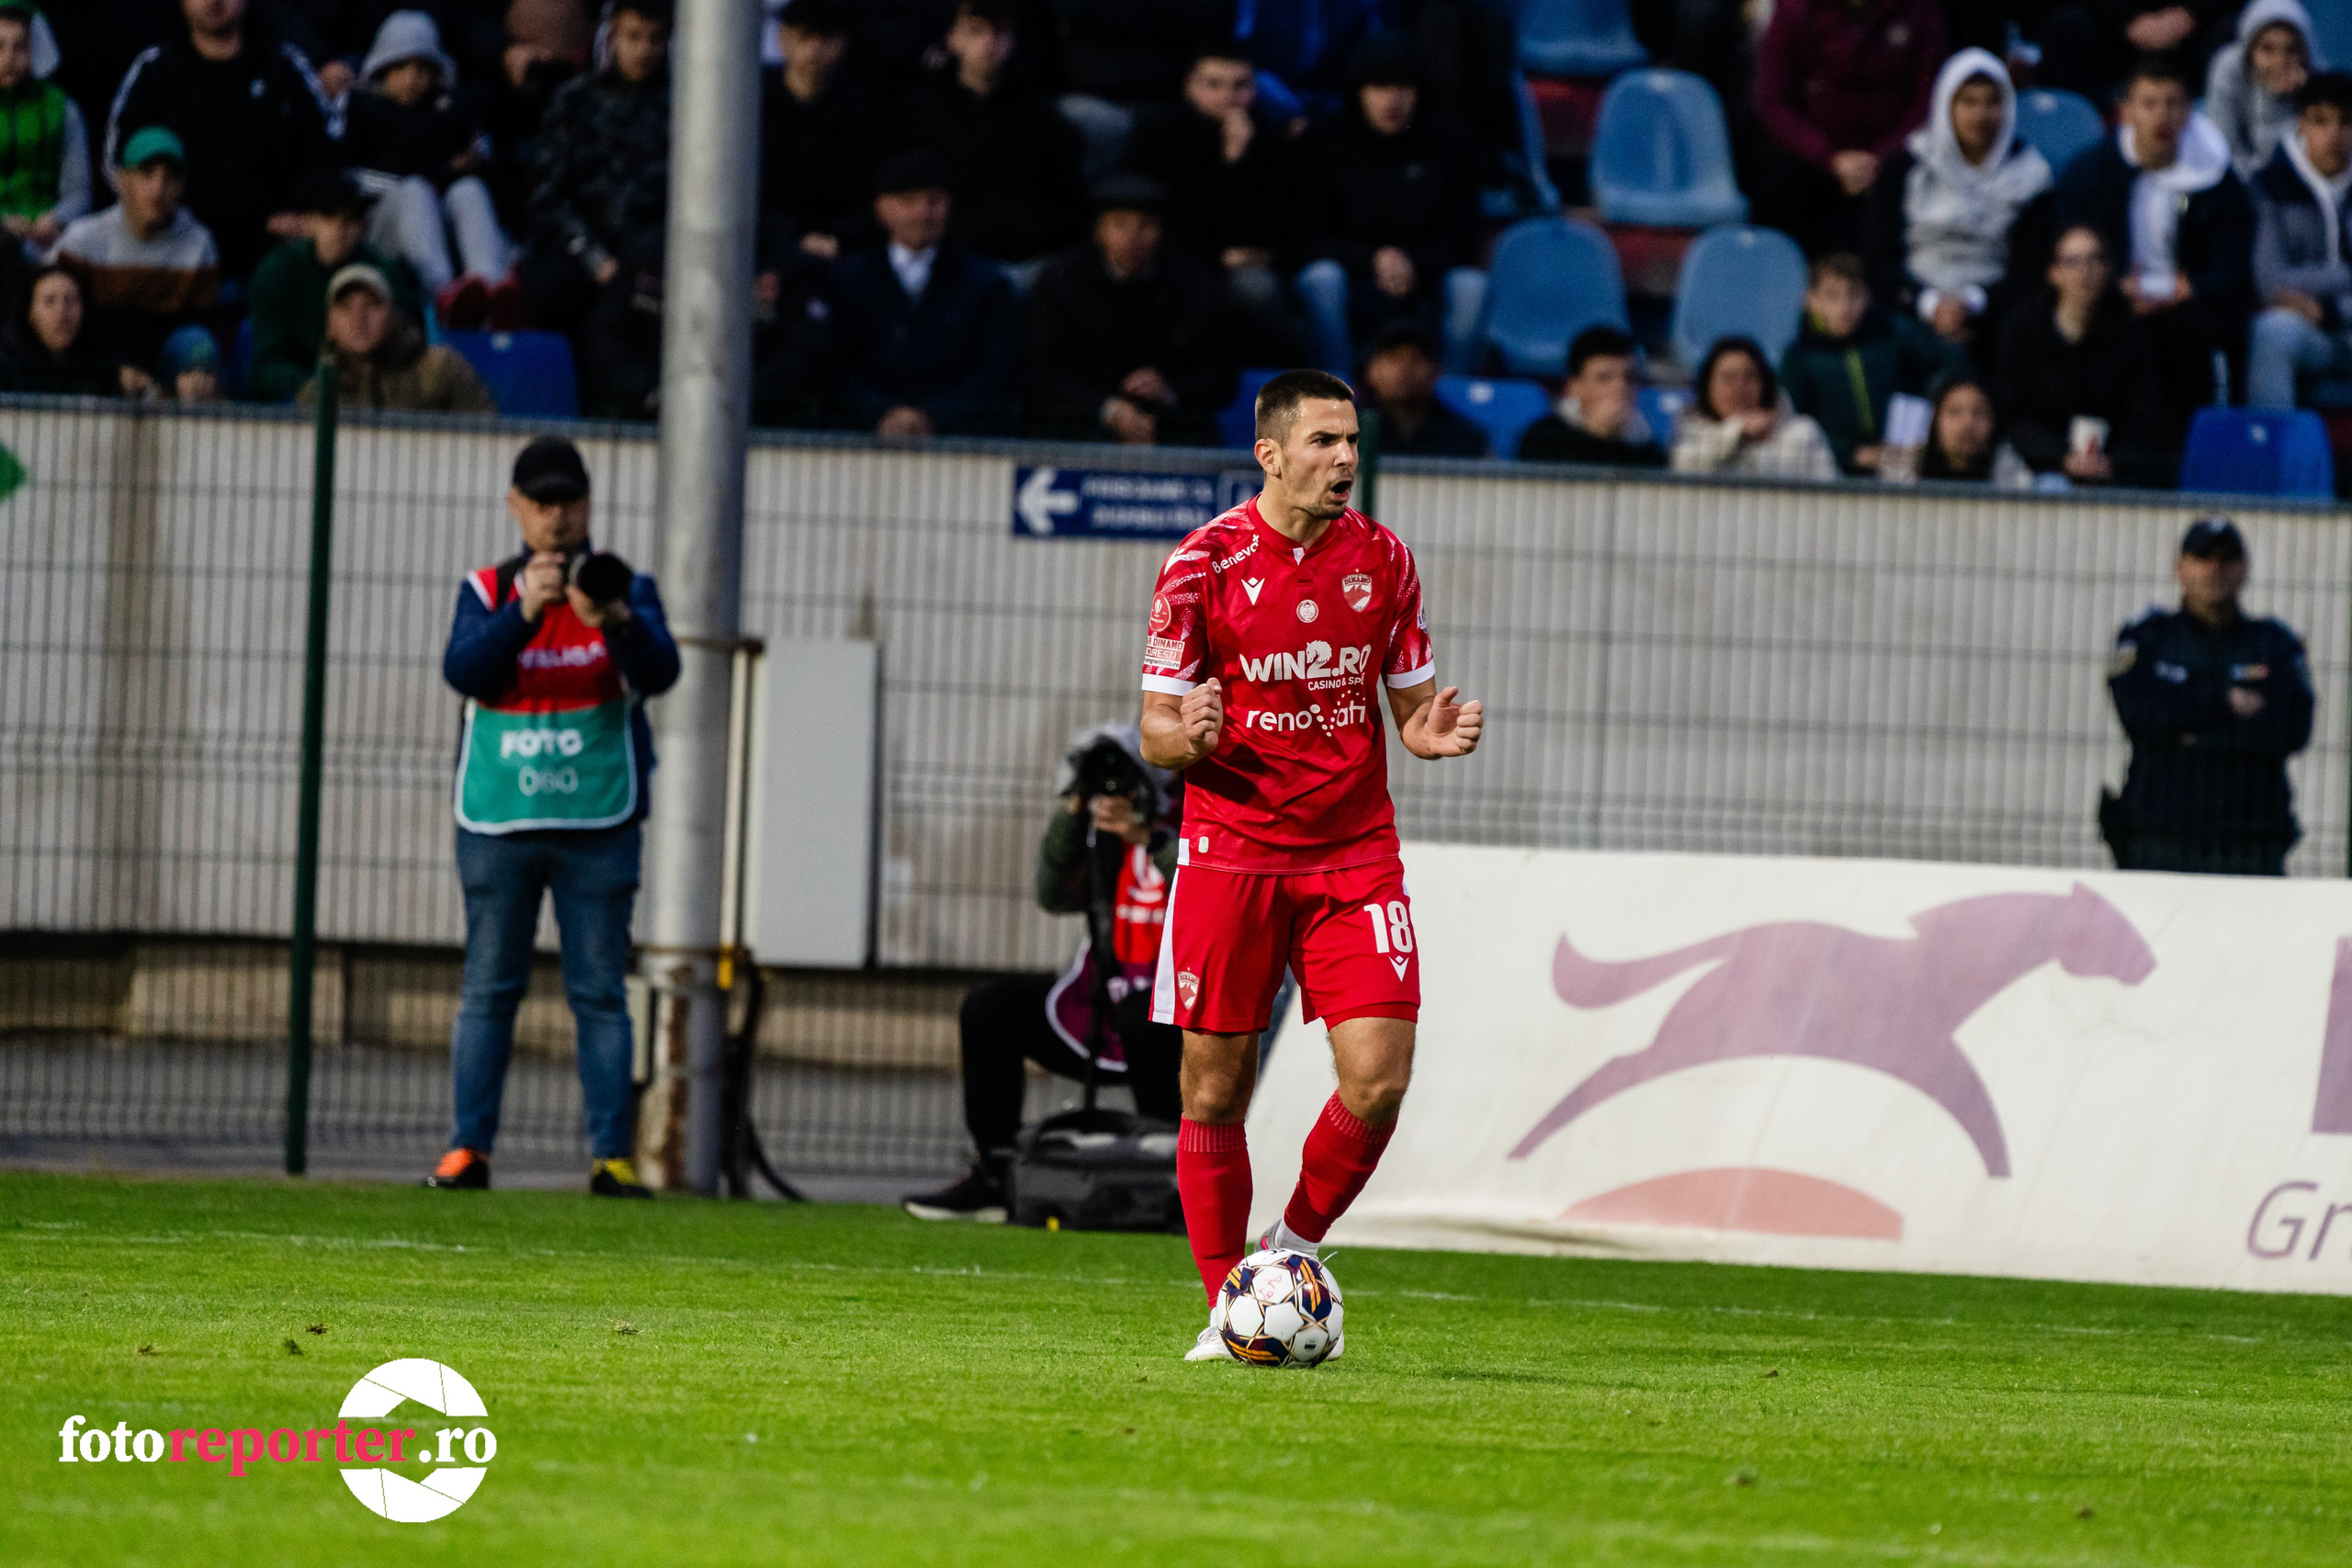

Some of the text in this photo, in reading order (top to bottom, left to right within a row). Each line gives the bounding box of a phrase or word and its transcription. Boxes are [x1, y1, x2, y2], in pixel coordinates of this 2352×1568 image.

[1153, 637, 1183, 650] DINAMO
[1307, 679, 1341, 691] CASINO
[1341, 677, 1347, 686] &
[501, 728, 583, 760] FOTO
[1363, 900, 1414, 953] 18
